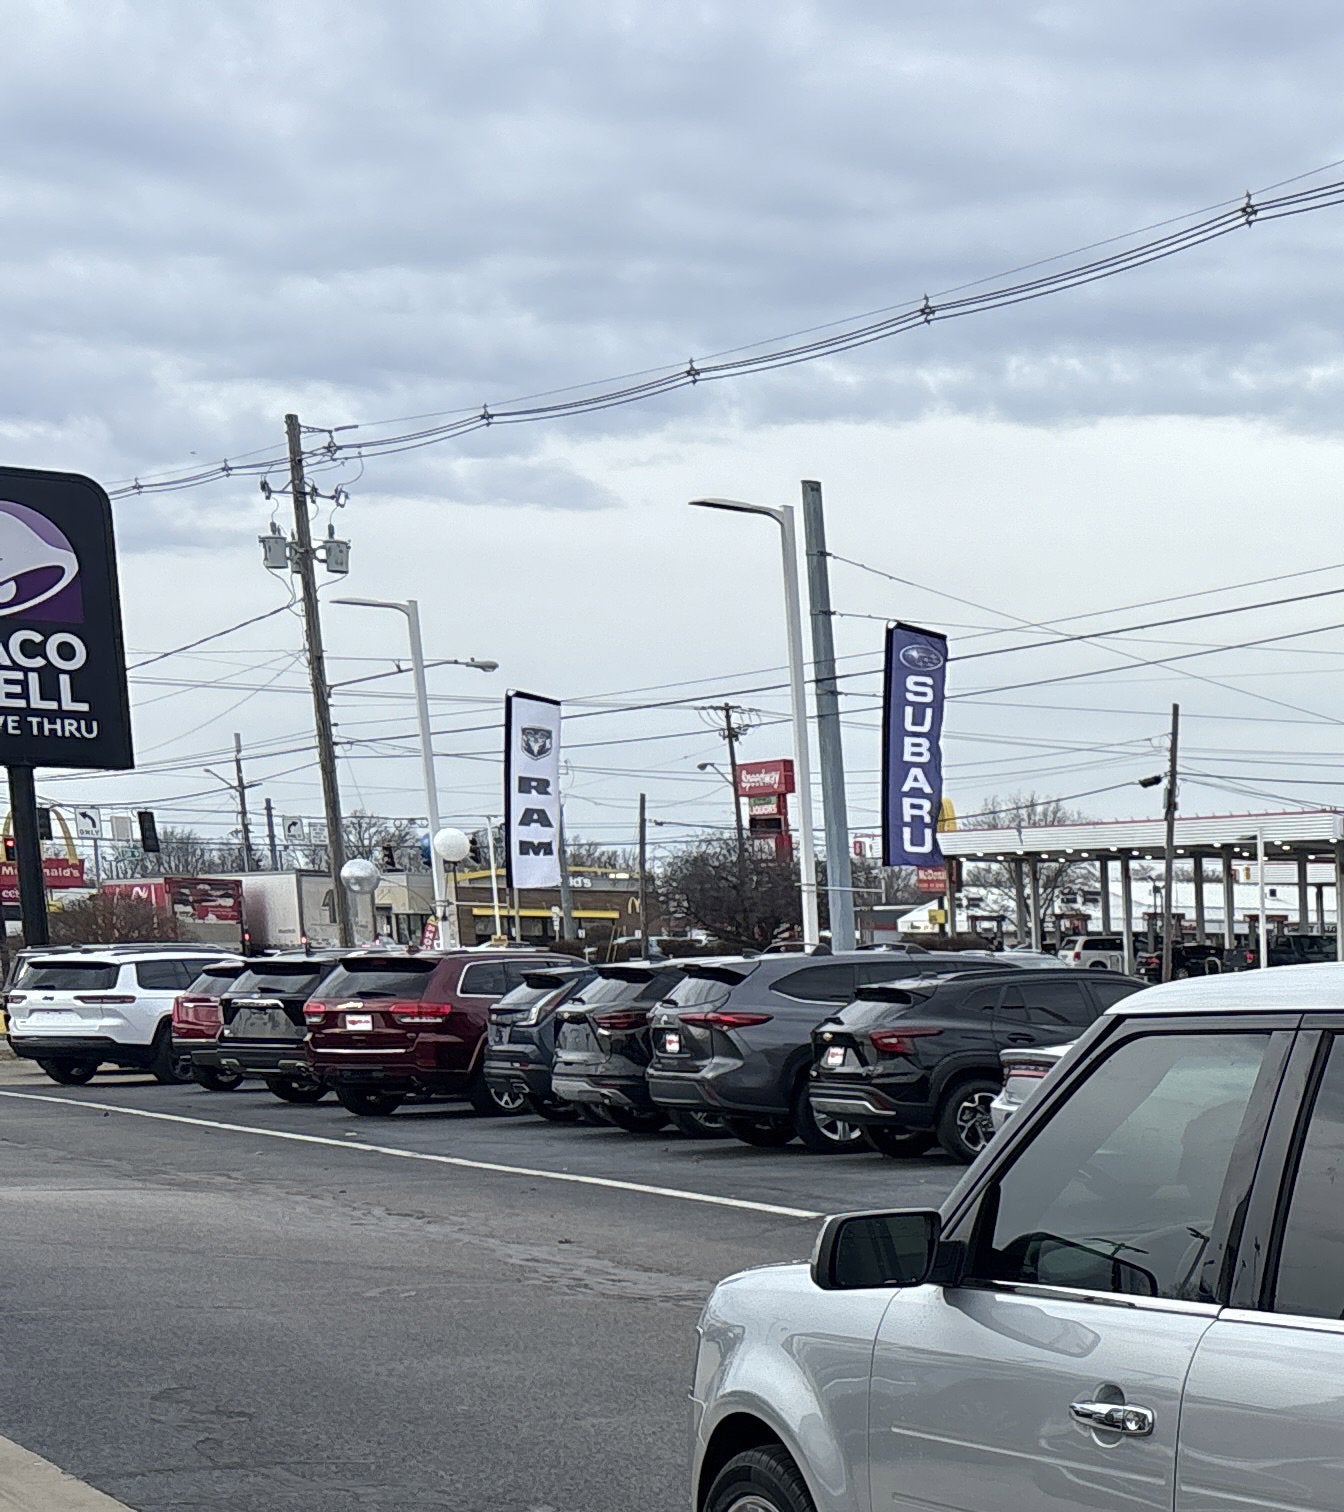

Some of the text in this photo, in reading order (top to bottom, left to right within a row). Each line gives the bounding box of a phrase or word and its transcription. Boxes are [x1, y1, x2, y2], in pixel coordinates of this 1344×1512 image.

[0, 629, 88, 671] CO
[0, 670, 90, 712] ELL
[27, 716, 98, 739] THRU
[901, 675, 934, 854] SUBARU
[518, 775, 554, 857] RAM
[1, 866, 81, 877] Mnald's
